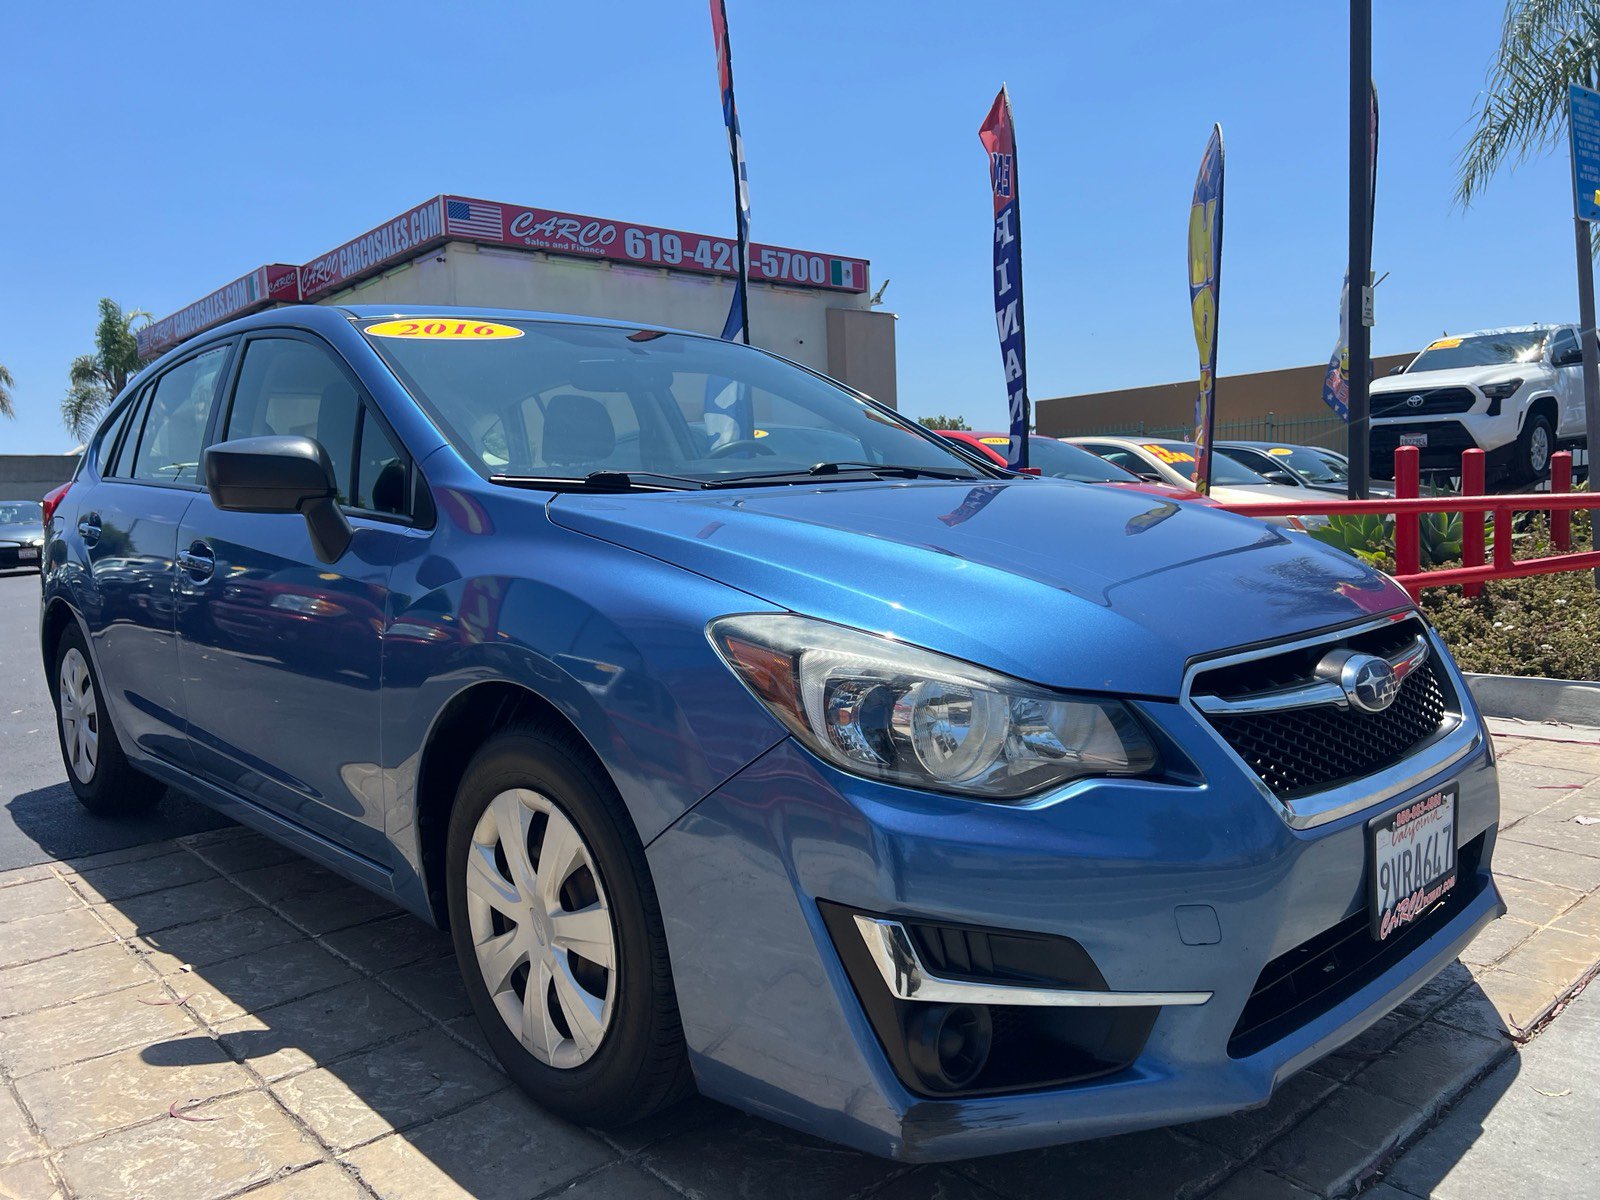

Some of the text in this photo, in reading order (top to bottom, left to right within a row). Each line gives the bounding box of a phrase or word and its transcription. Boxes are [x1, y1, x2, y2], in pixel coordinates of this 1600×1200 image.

[510, 211, 617, 246] CARCO
[524, 237, 605, 255] Sales and Finance
[302, 201, 441, 292] CARCO CARCOSALES.COM
[398, 323, 494, 336] 2016
[1380, 824, 1451, 916] 9VRA647
